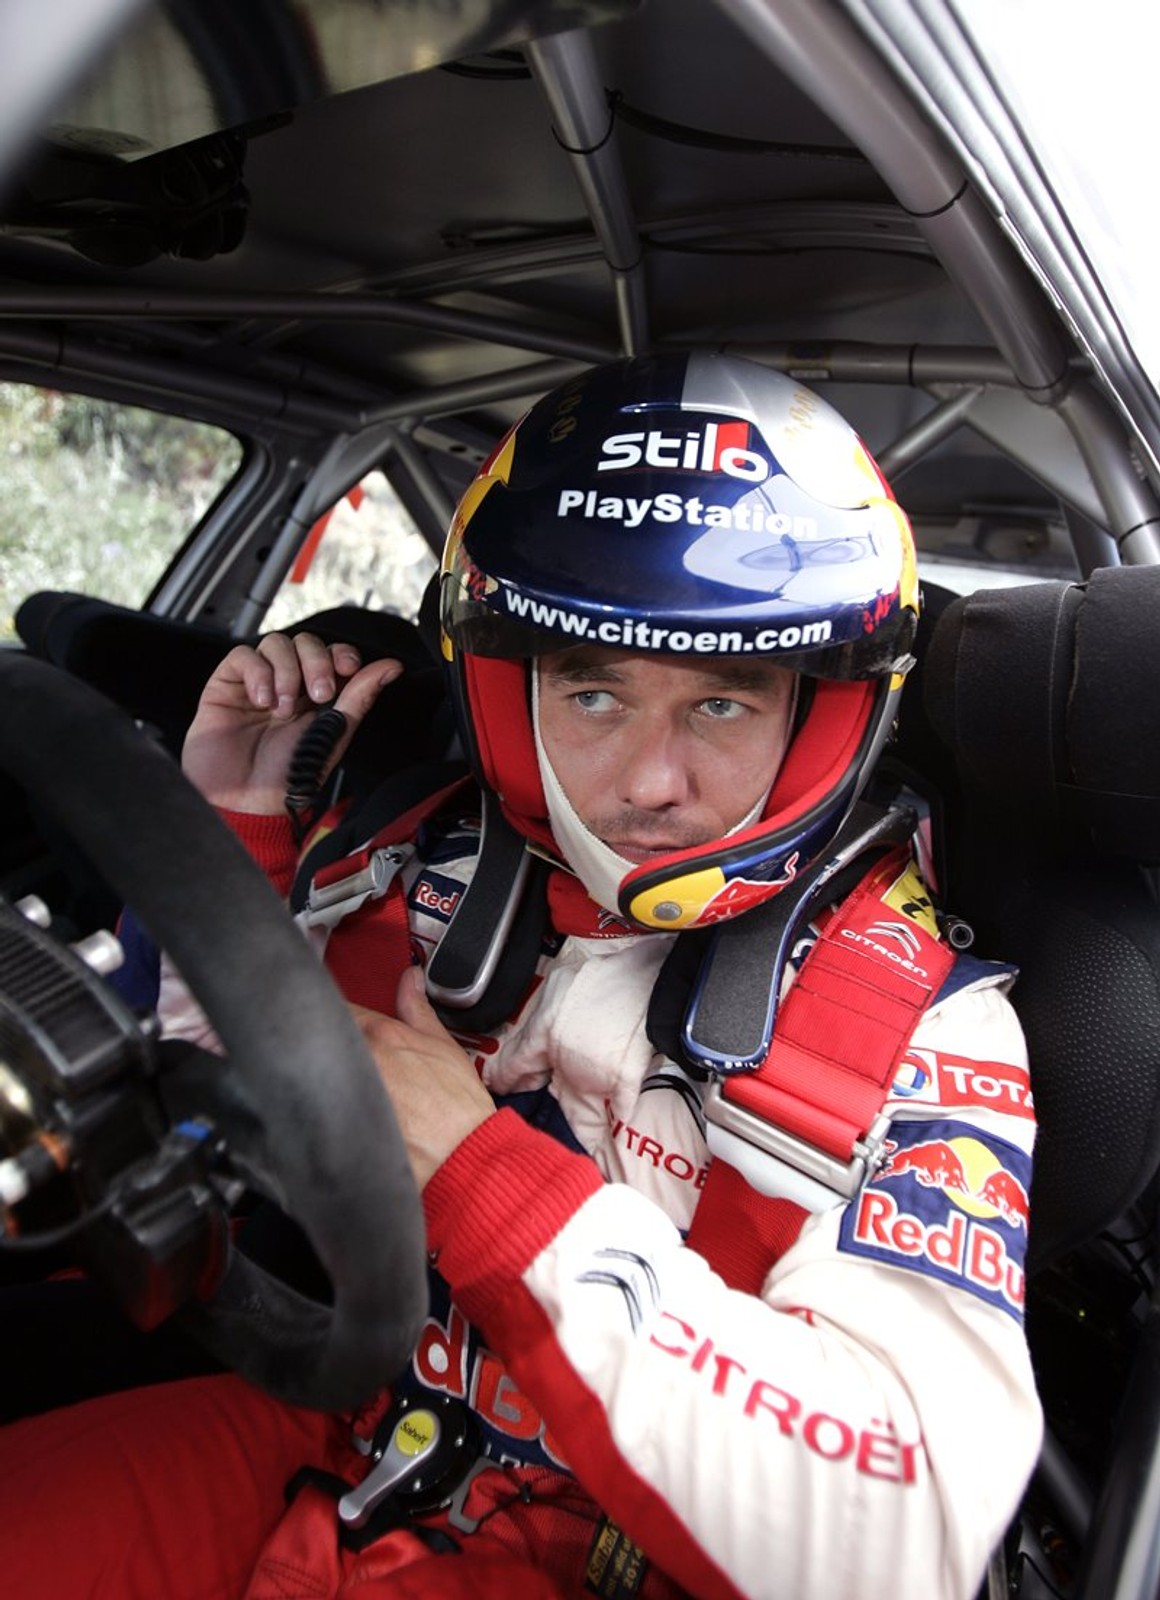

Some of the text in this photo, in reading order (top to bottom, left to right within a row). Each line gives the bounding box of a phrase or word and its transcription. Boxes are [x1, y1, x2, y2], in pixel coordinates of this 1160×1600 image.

[557, 489, 819, 540] PlayStation
[504, 589, 832, 653] www.citroen.com
[414, 881, 460, 915] Red
